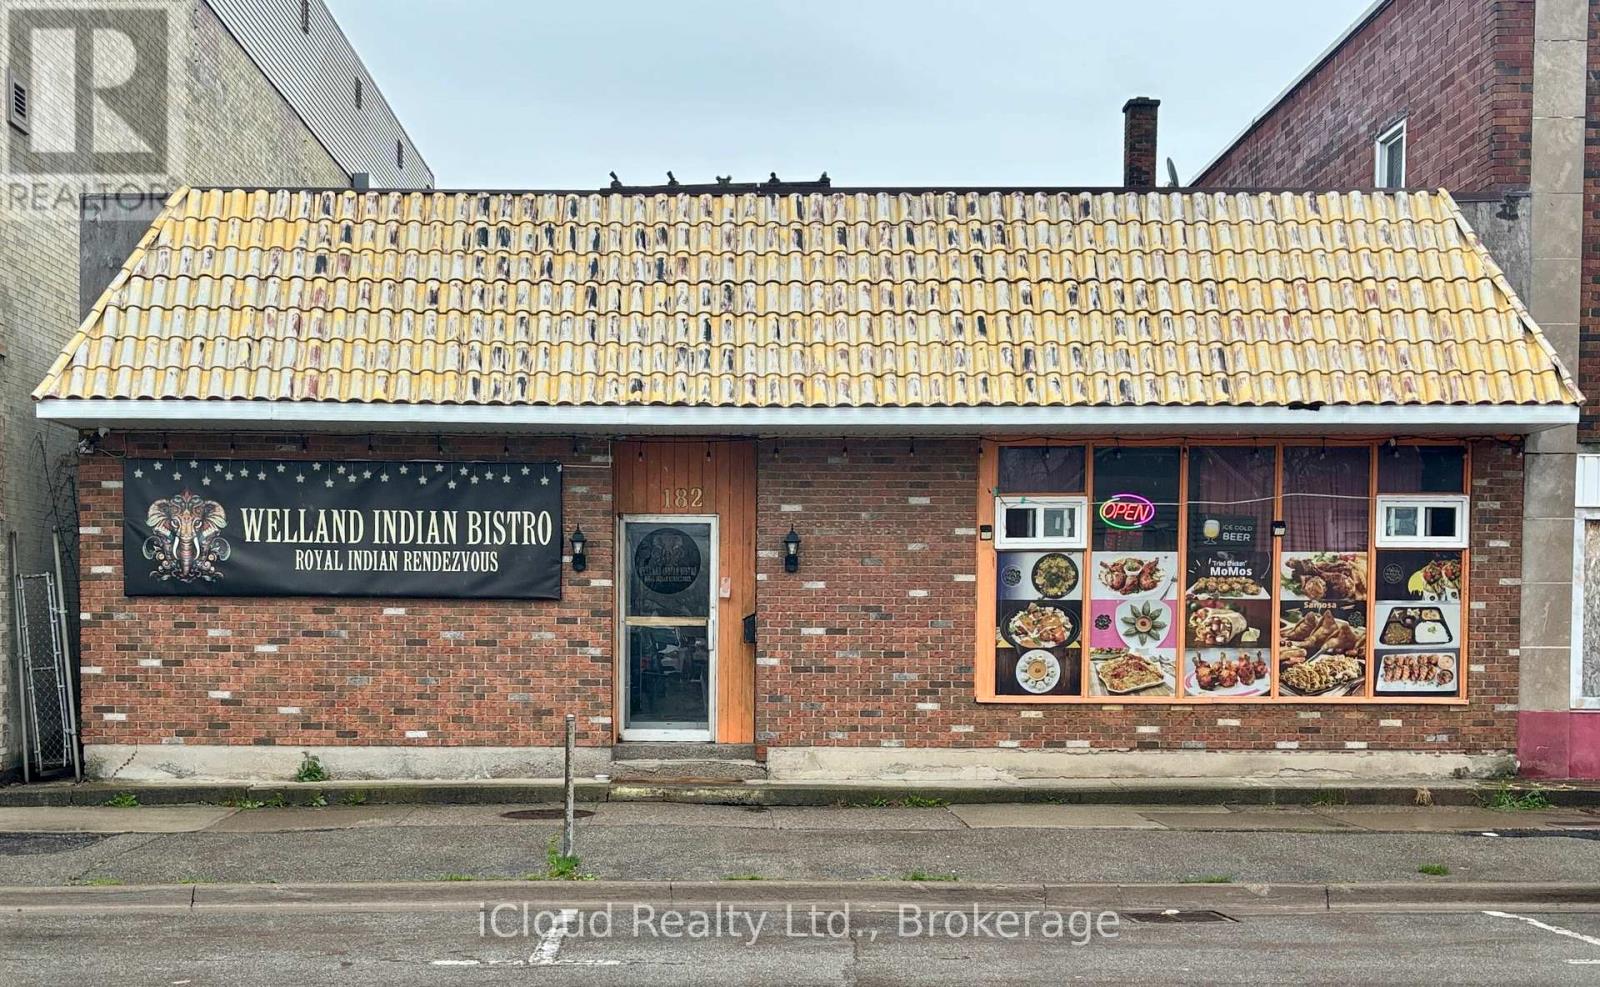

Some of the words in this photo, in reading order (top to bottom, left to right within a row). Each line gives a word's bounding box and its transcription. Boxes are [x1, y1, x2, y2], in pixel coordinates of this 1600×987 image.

[663, 487, 704, 508] 182
[1102, 502, 1150, 521] OPEN
[240, 508, 364, 544] WELLAND
[373, 509, 458, 545] INDIAN
[467, 510, 553, 546] BISTRO
[1222, 532, 1251, 542] BEER
[295, 549, 344, 571] ROYAL
[348, 550, 398, 572] INDIAN
[403, 551, 499, 573] RENDEZVOUS
[1210, 566, 1253, 576] MoMos
[1303, 601, 1337, 609] Samosa
